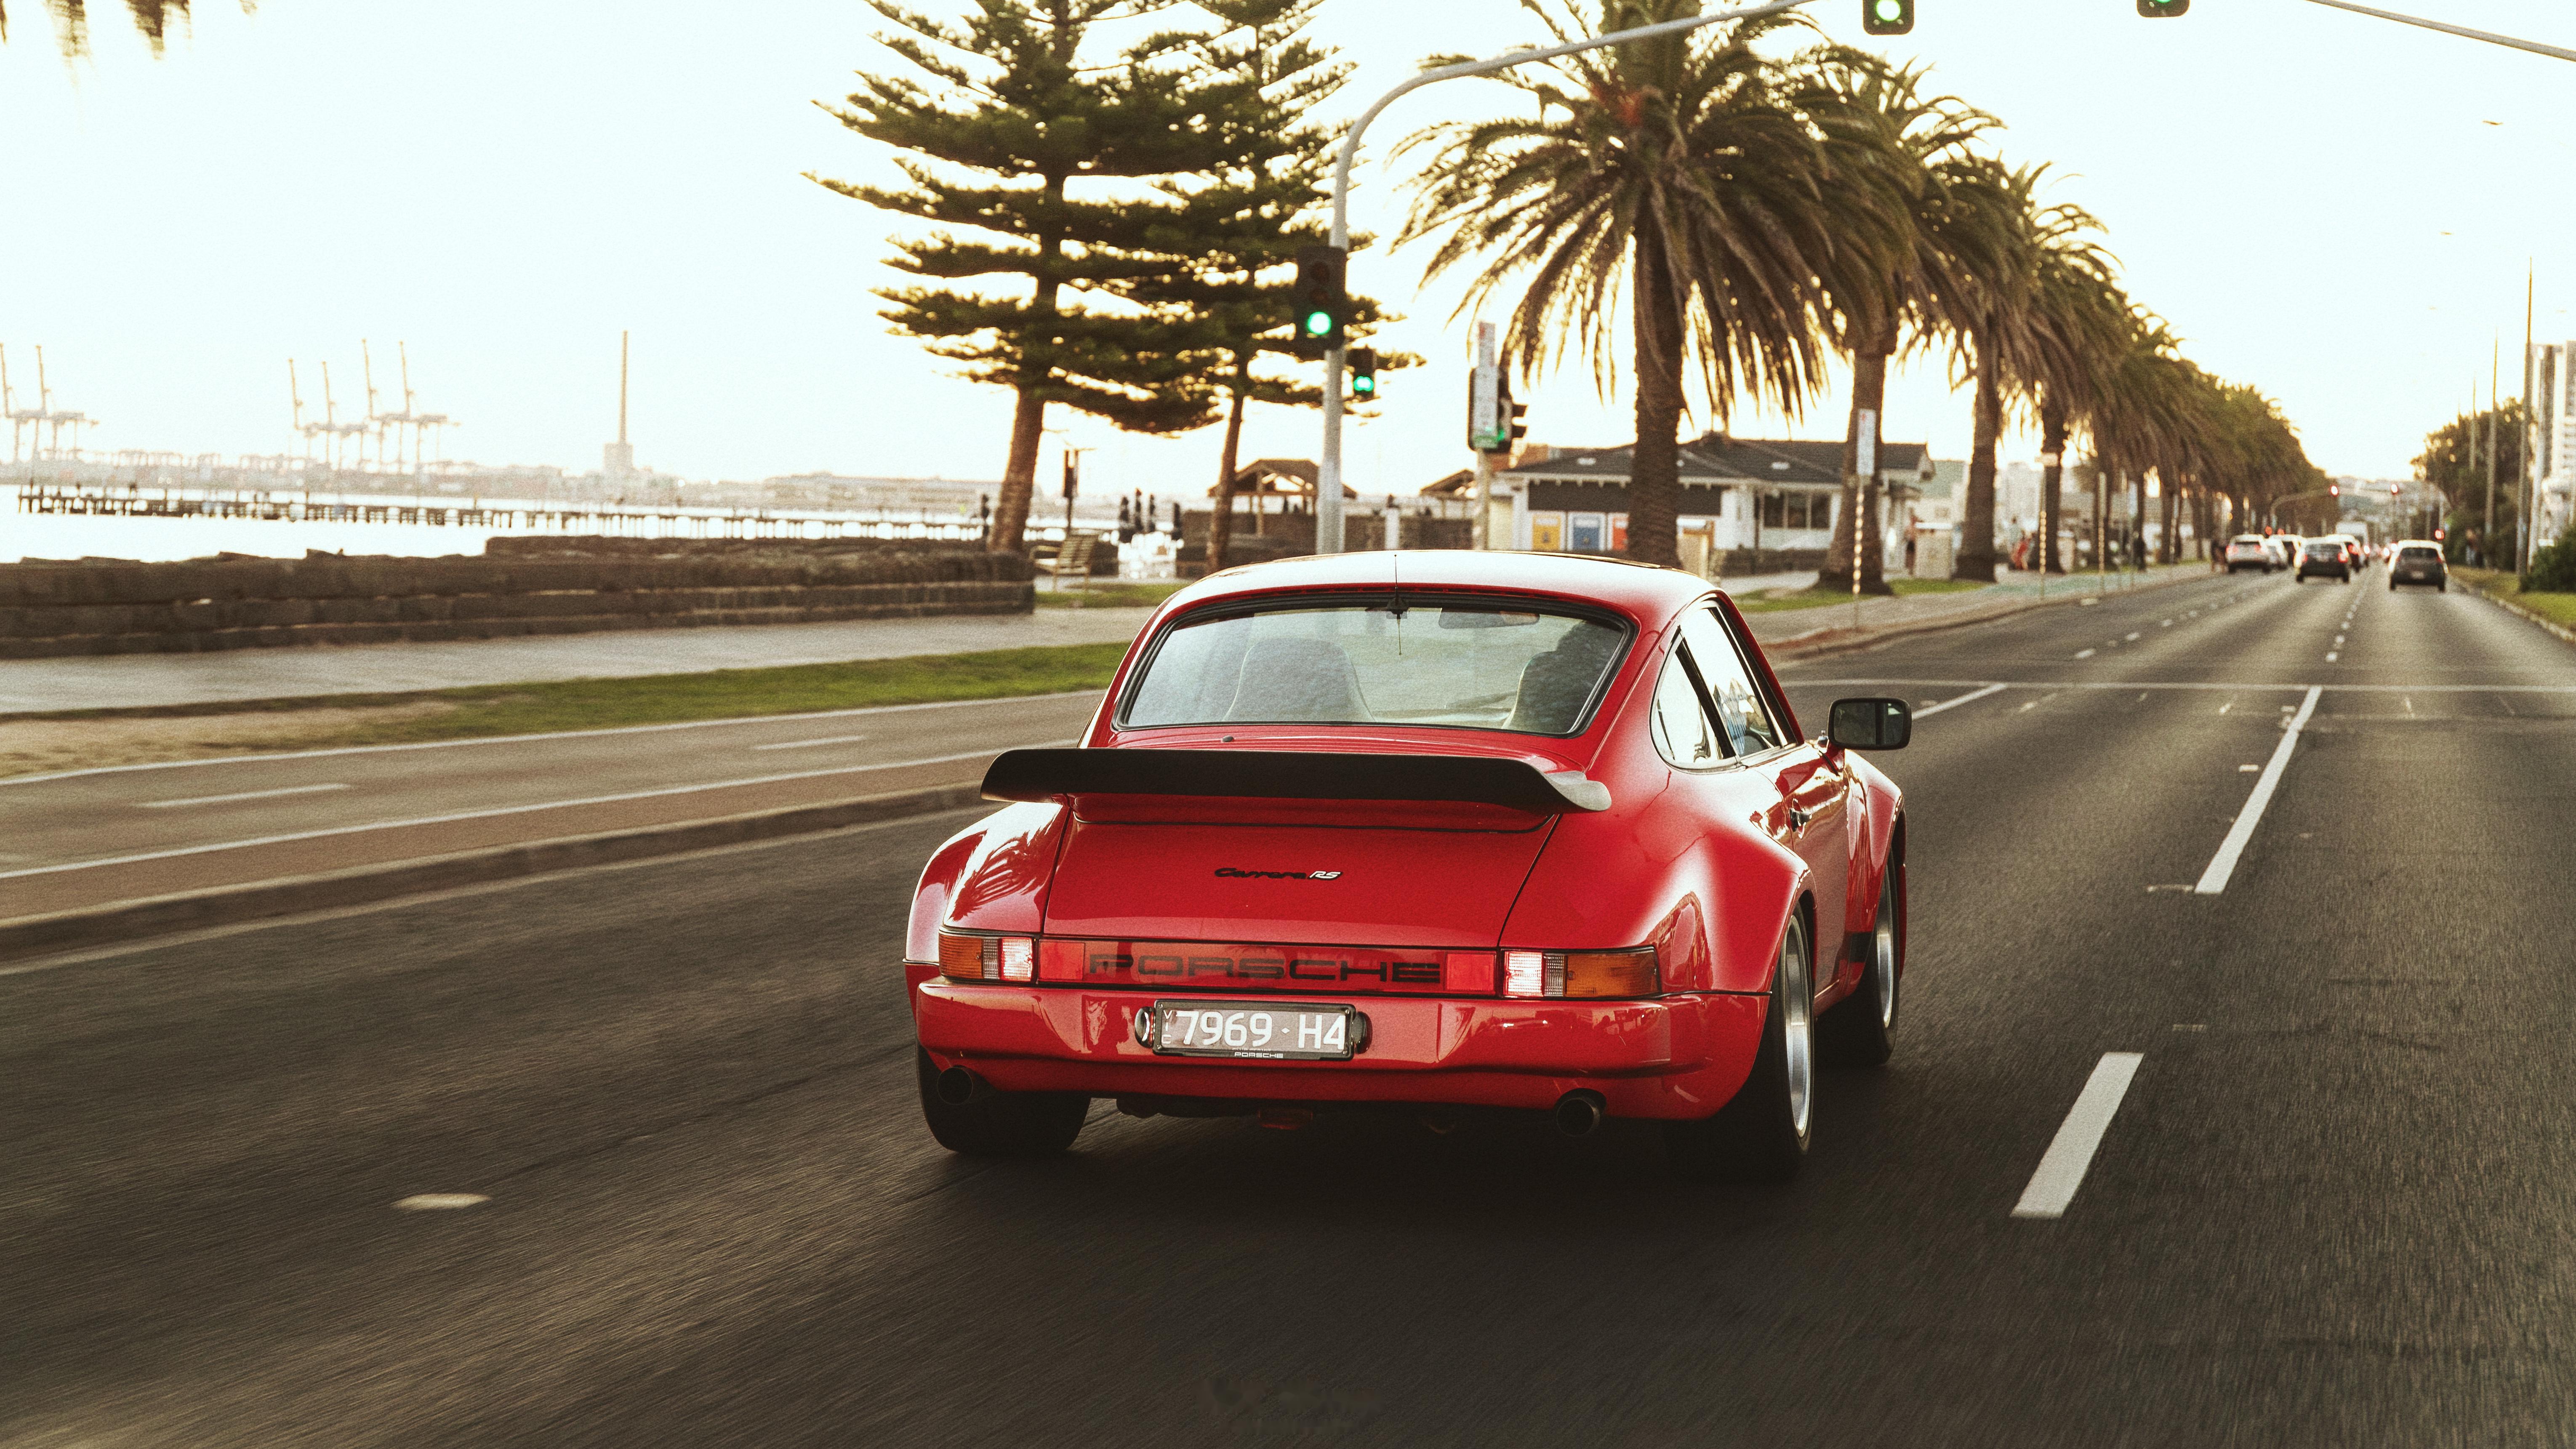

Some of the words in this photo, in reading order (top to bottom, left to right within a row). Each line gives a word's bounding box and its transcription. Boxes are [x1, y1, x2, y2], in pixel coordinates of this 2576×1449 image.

[1215, 867, 1307, 879] Carrera
[1307, 870, 1343, 881] RS
[1090, 954, 1440, 983] PORSCHE
[1161, 1010, 1173, 1044] VIC
[1176, 1011, 1272, 1047] 7969
[1298, 1015, 1345, 1049] H4
